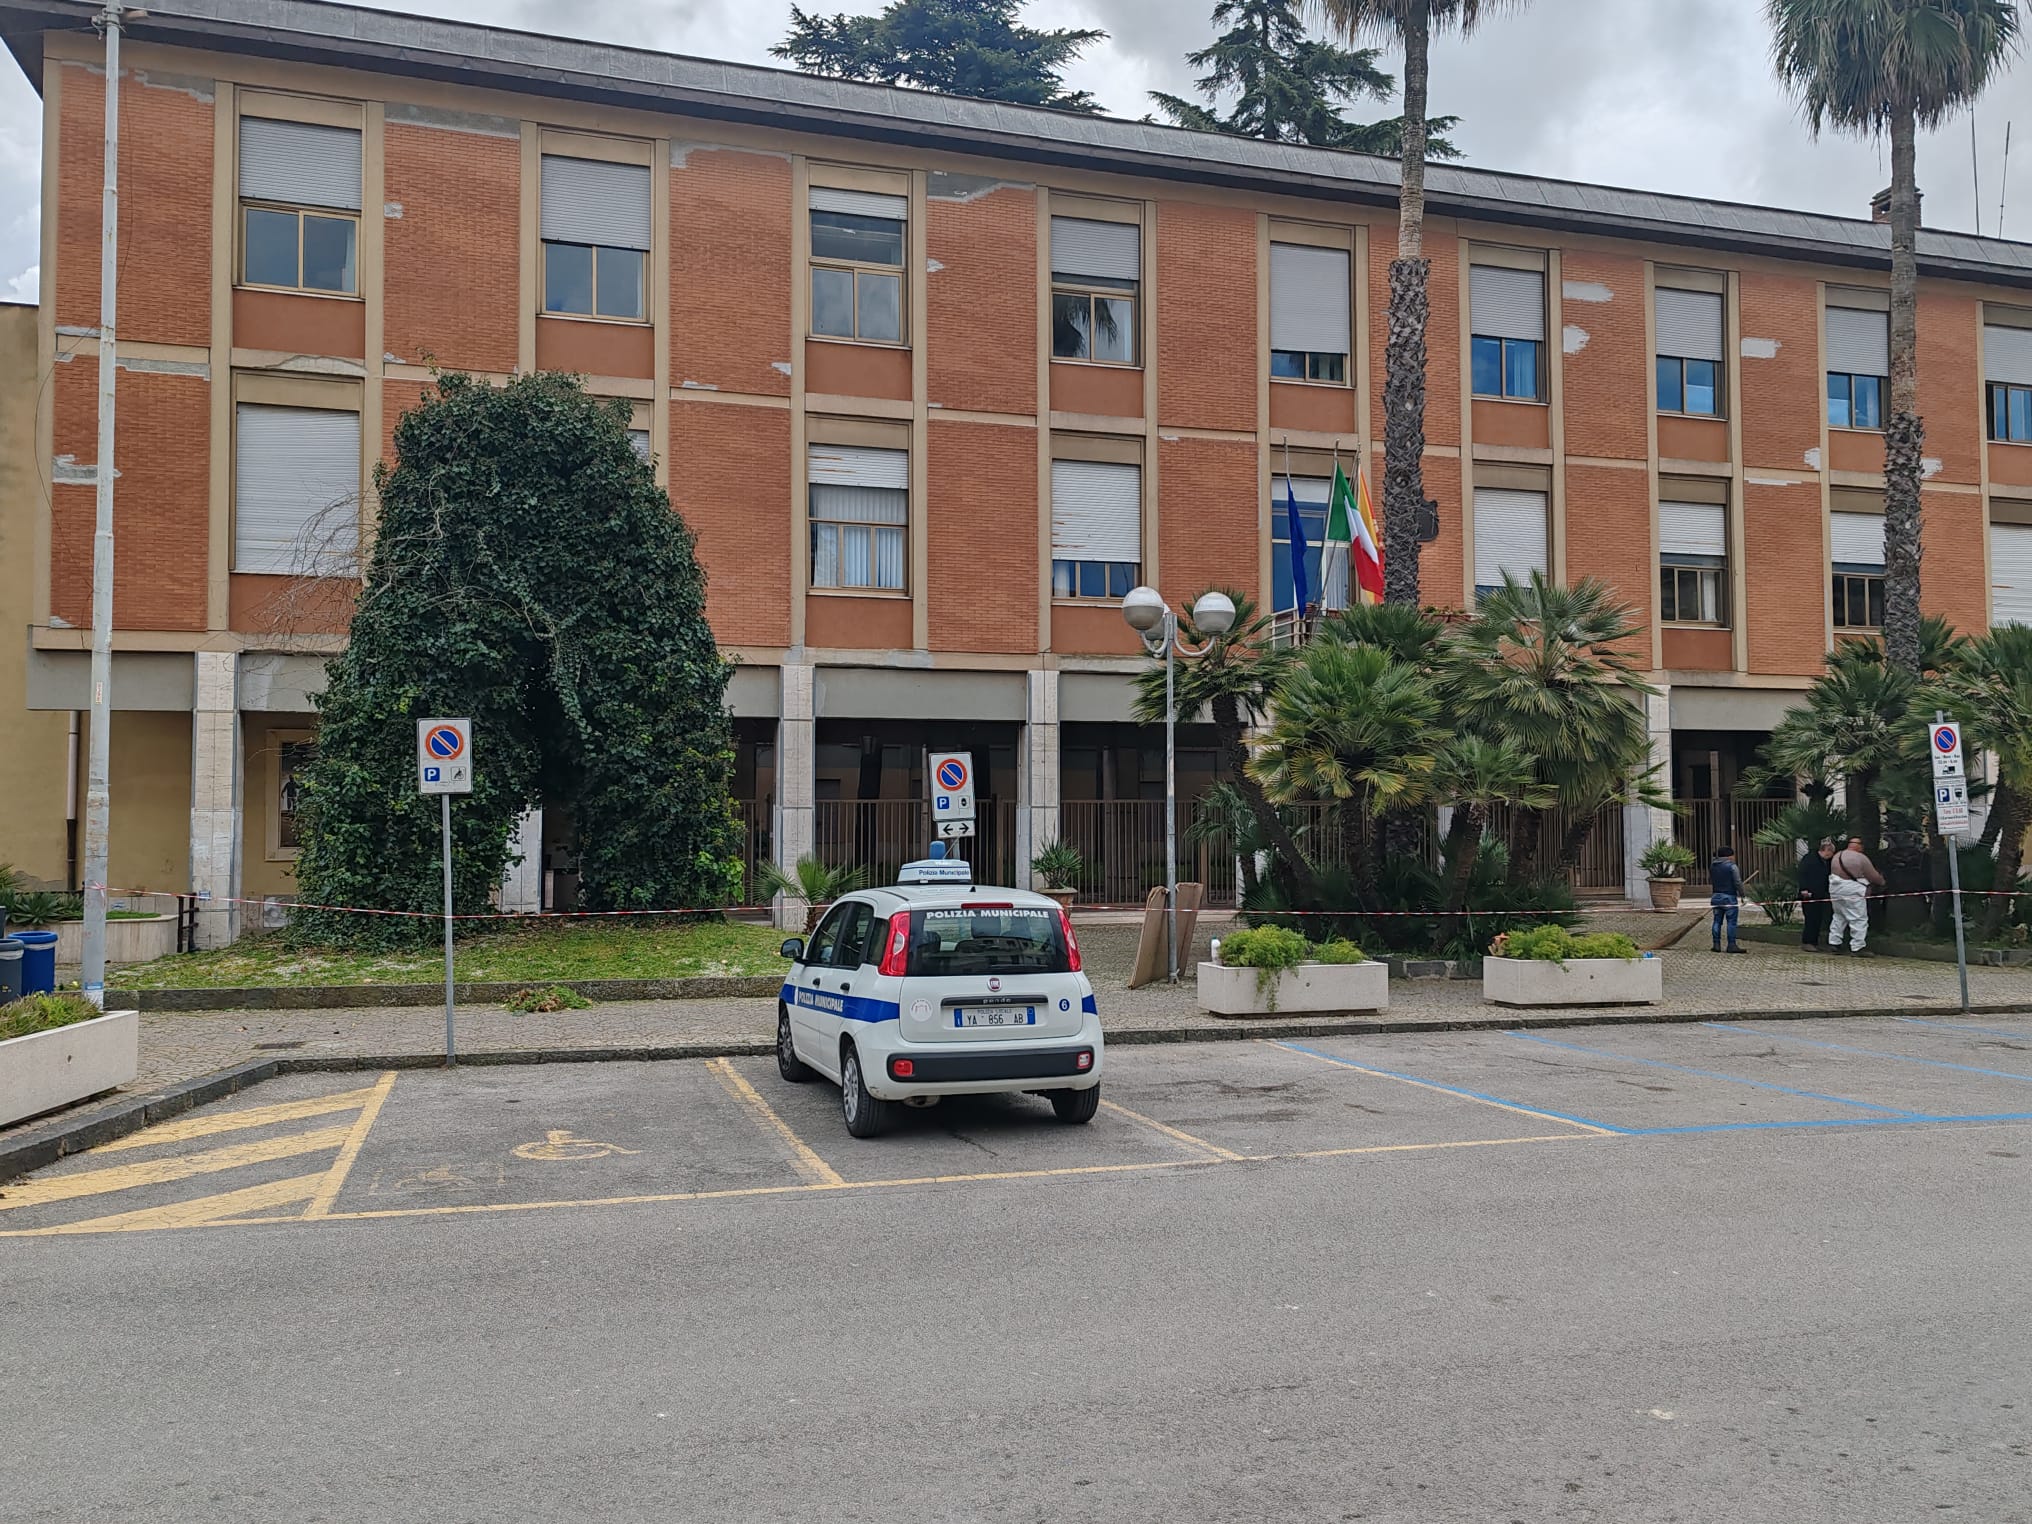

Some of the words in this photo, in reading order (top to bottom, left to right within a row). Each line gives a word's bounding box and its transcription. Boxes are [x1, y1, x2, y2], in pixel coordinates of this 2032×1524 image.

[427, 769, 437, 780] P
[1939, 790, 1948, 802] P
[939, 798, 947, 808] P
[939, 869, 970, 877] Municipale
[926, 910, 976, 919] POLIZIA
[980, 909, 1049, 918] MUNICIPALE
[799, 991, 814, 1004] POLIZIA
[814, 994, 844, 1012] MUNICIPALE
[1061, 1000, 1067, 1010] 6
[967, 1015, 978, 1025] YA
[988, 1014, 1004, 1024] 856
[1014, 1013, 1024, 1024] AB
